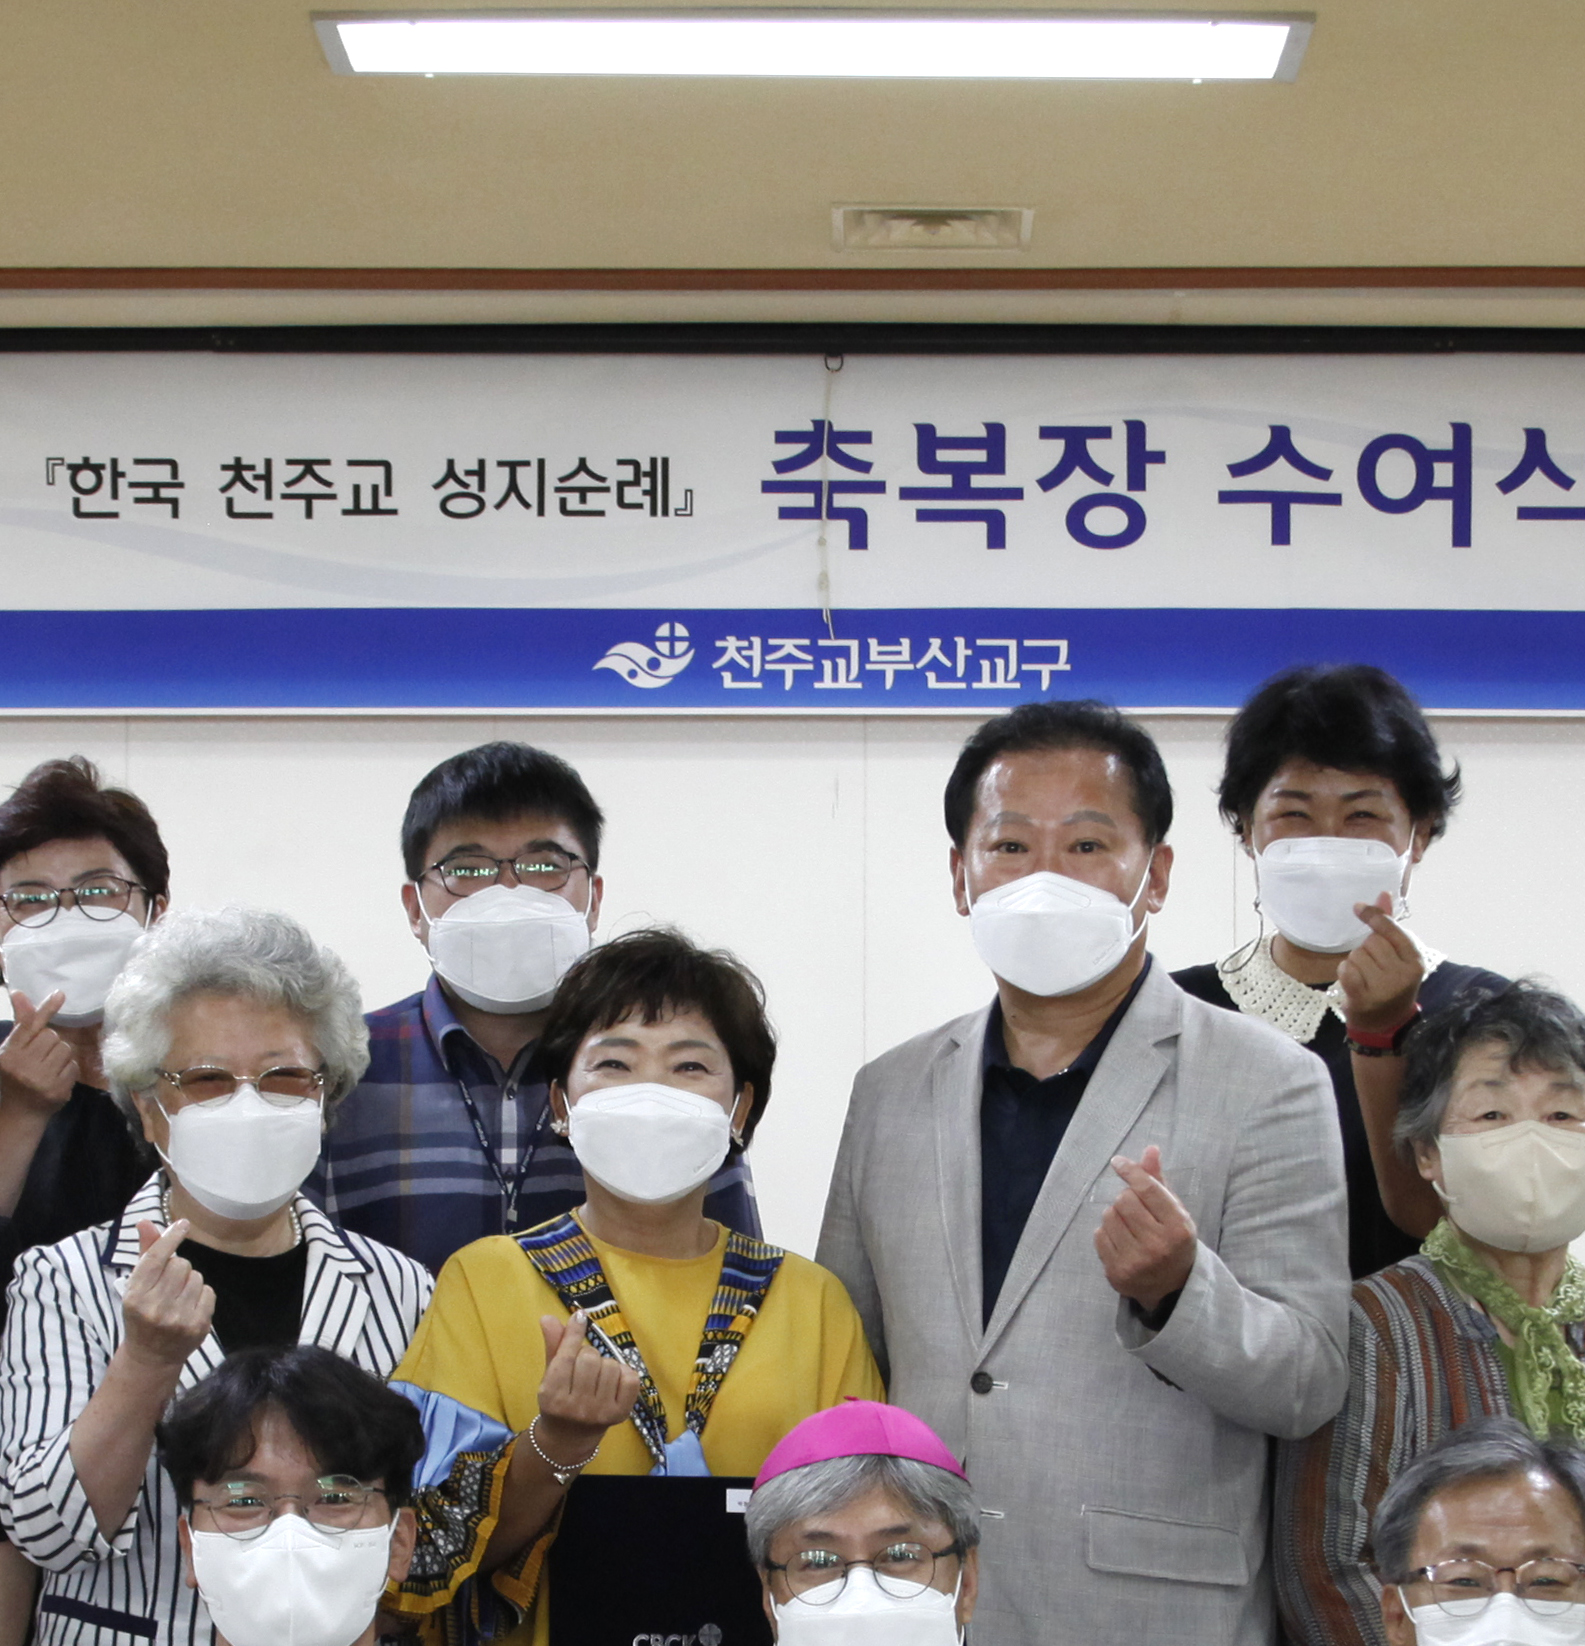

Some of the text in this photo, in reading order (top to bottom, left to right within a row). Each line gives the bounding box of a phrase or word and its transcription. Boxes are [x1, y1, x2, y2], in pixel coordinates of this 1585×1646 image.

[45, 456, 185, 519] 『한국
[218, 456, 399, 519] 천주교
[431, 456, 693, 519] 성지순례』
[761, 419, 1166, 550] 축복장
[712, 635, 1072, 691] 천주교부산교구
